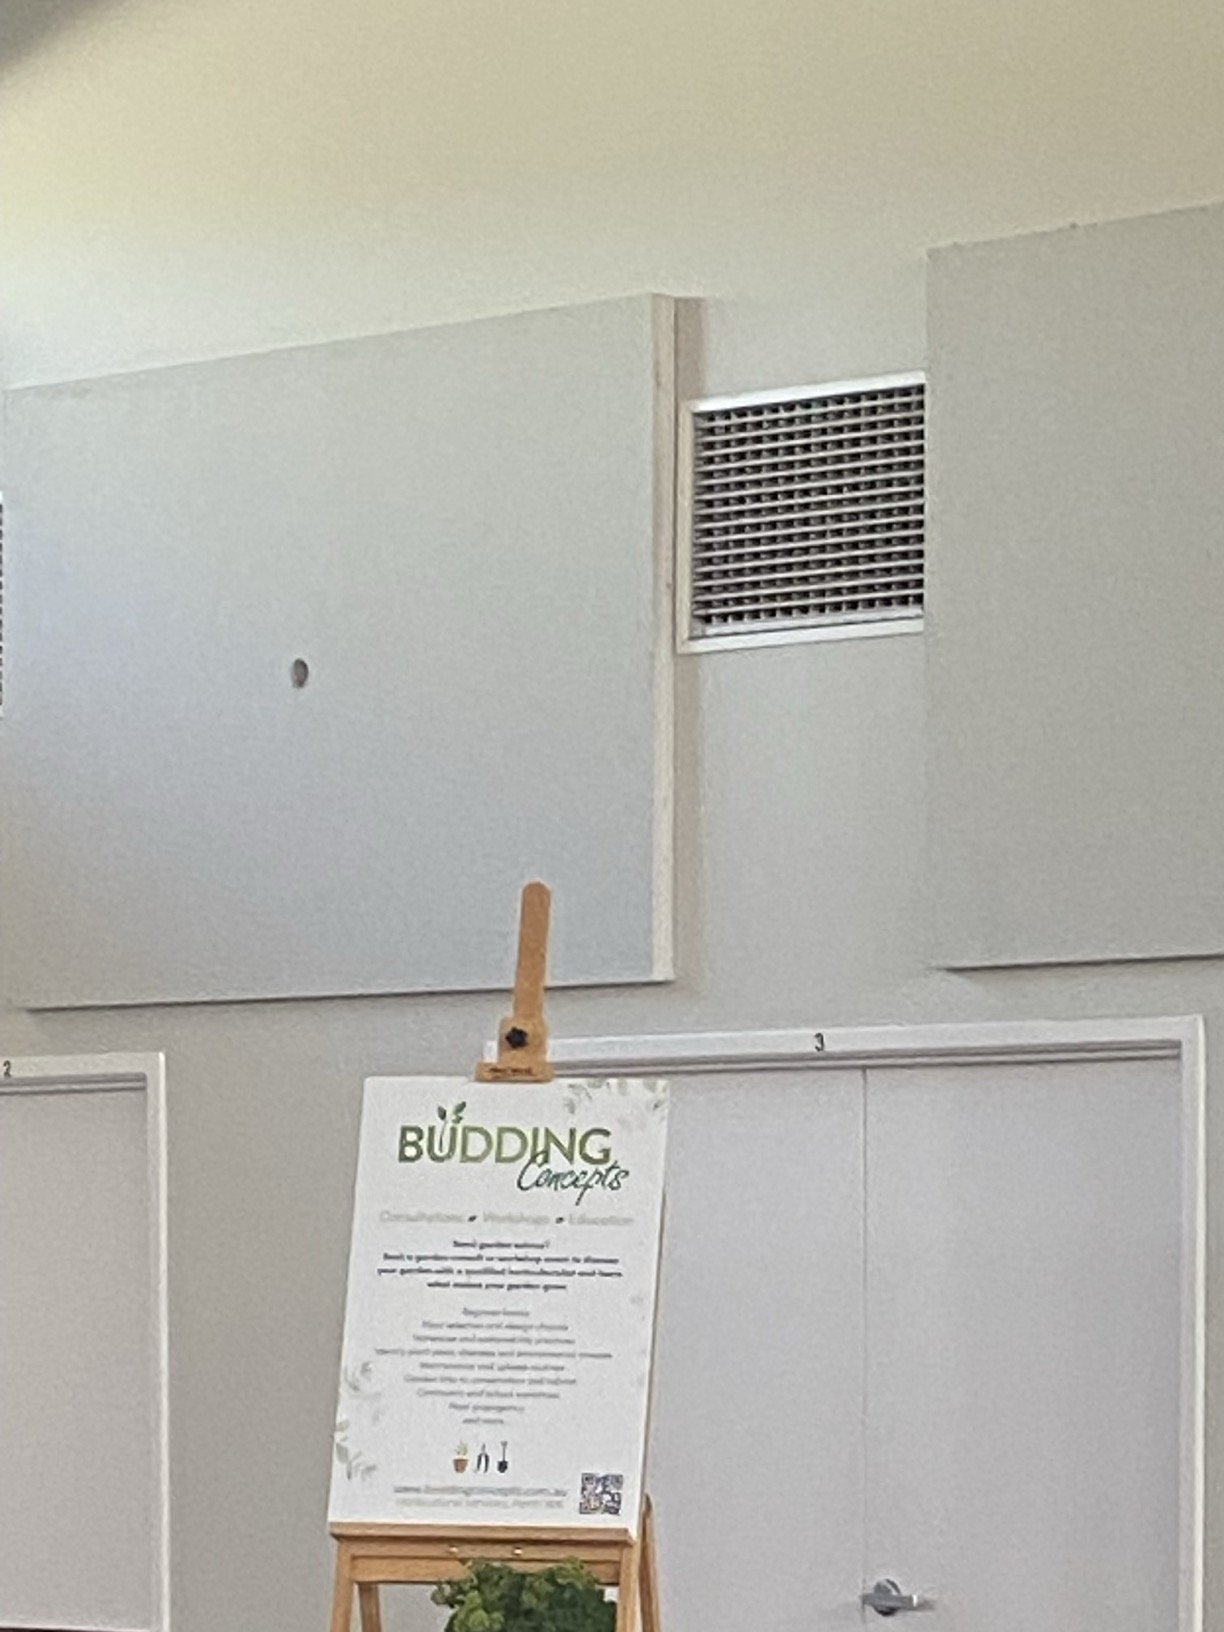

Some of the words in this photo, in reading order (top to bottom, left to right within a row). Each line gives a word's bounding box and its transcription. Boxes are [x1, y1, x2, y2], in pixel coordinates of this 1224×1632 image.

[814, 1031, 824, 1052] 3
[3, 1059, 12, 1078] 2
[398, 1124, 612, 1165] BUDDING
[516, 1149, 630, 1206] Concepts
